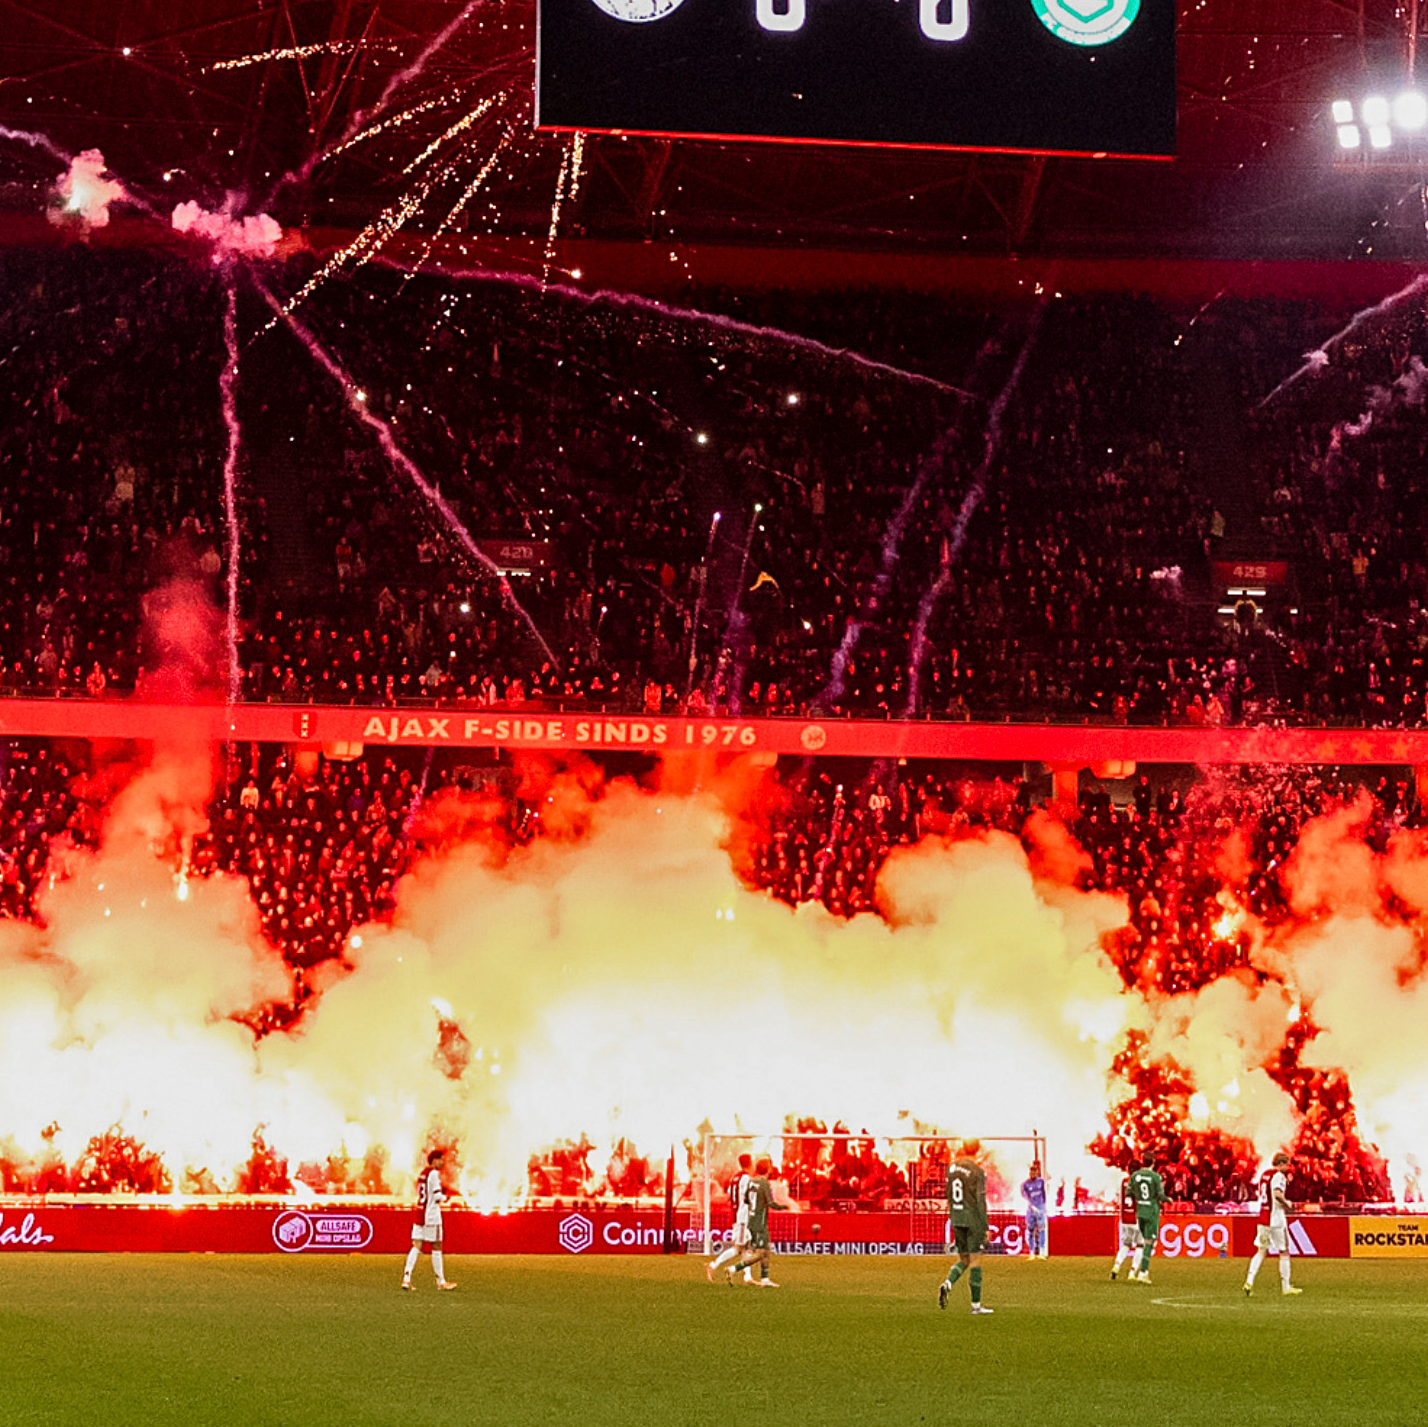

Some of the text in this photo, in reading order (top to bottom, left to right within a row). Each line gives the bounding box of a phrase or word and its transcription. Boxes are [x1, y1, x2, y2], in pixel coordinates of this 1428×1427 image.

[362, 716, 758, 746] AJAX F-SIDE SINDS 1976
[952, 1178, 964, 1204] 6
[1140, 1182, 1150, 1201] 9
[320, 1220, 358, 1232] ALLSAFE
[1397, 1224, 1419, 1232] TEAM
[834, 1242, 867, 1255] MINI
[869, 1242, 924, 1255] OPSLAG
